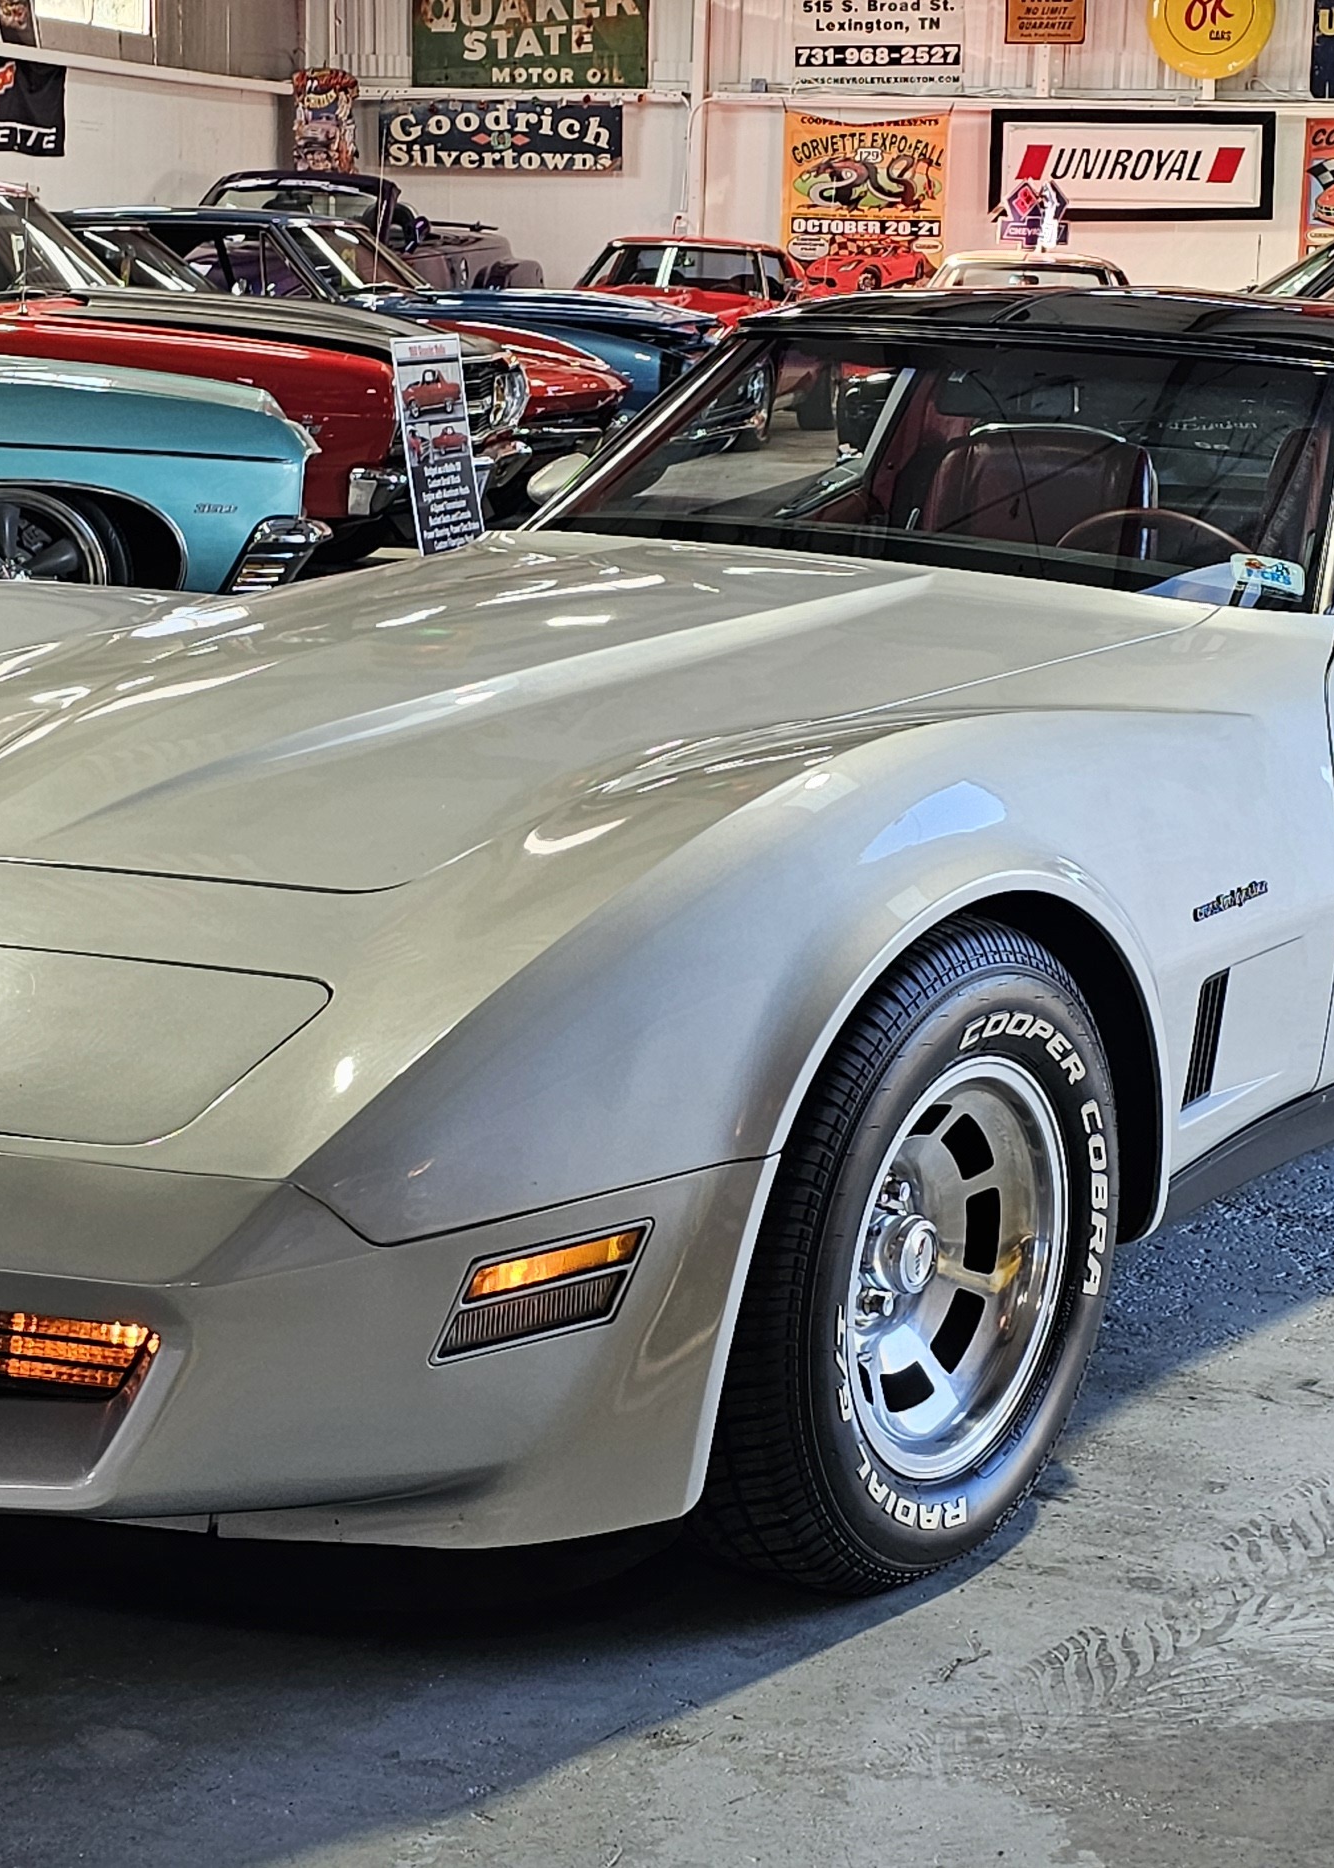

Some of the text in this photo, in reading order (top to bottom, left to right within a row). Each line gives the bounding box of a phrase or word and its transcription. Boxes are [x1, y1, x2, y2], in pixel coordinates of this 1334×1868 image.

[803, 0, 955, 13] 515 S. Broad St.
[1024, 6, 1068, 15] NO LIMIT
[816, 17, 940, 33] Lexington, TN
[1019, 21, 1073, 30] GUARANTEE
[463, 24, 593, 61] STATE
[797, 46, 959, 65] 731-968-2527
[492, 67, 624, 84] MOTOR OIL
[390, 104, 610, 149] Goodrich
[388, 143, 613, 171] Silvertowns
[791, 132, 866, 165] CORVETTE
[1051, 148, 1202, 181] UNIROYAL
[792, 218, 940, 236] OCTOBER 20-21
[959, 1011, 1109, 1297] COOPER COBRA
[856, 1441, 967, 1530] RADIAL
